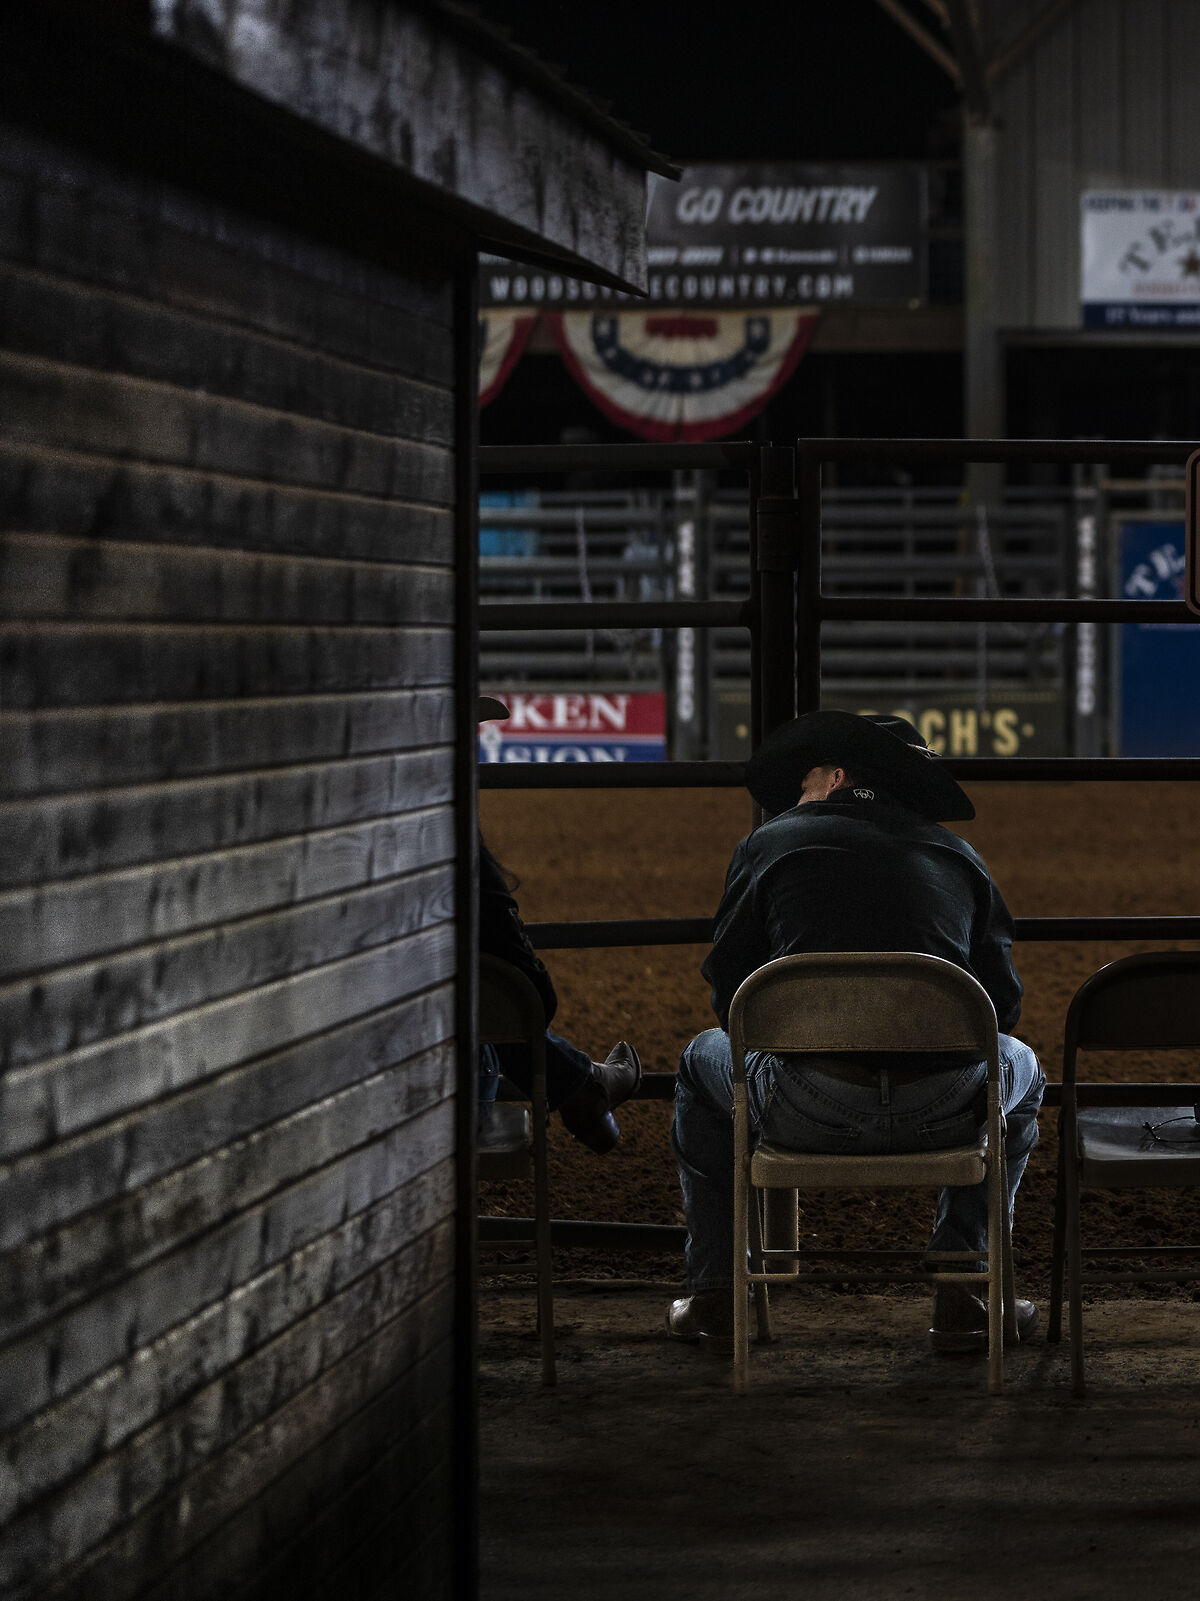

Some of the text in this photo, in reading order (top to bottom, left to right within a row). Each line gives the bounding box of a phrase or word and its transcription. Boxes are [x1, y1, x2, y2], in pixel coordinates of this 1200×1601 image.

[676, 186, 878, 224] GO COUNTRY
[498, 693, 633, 731] KEN
